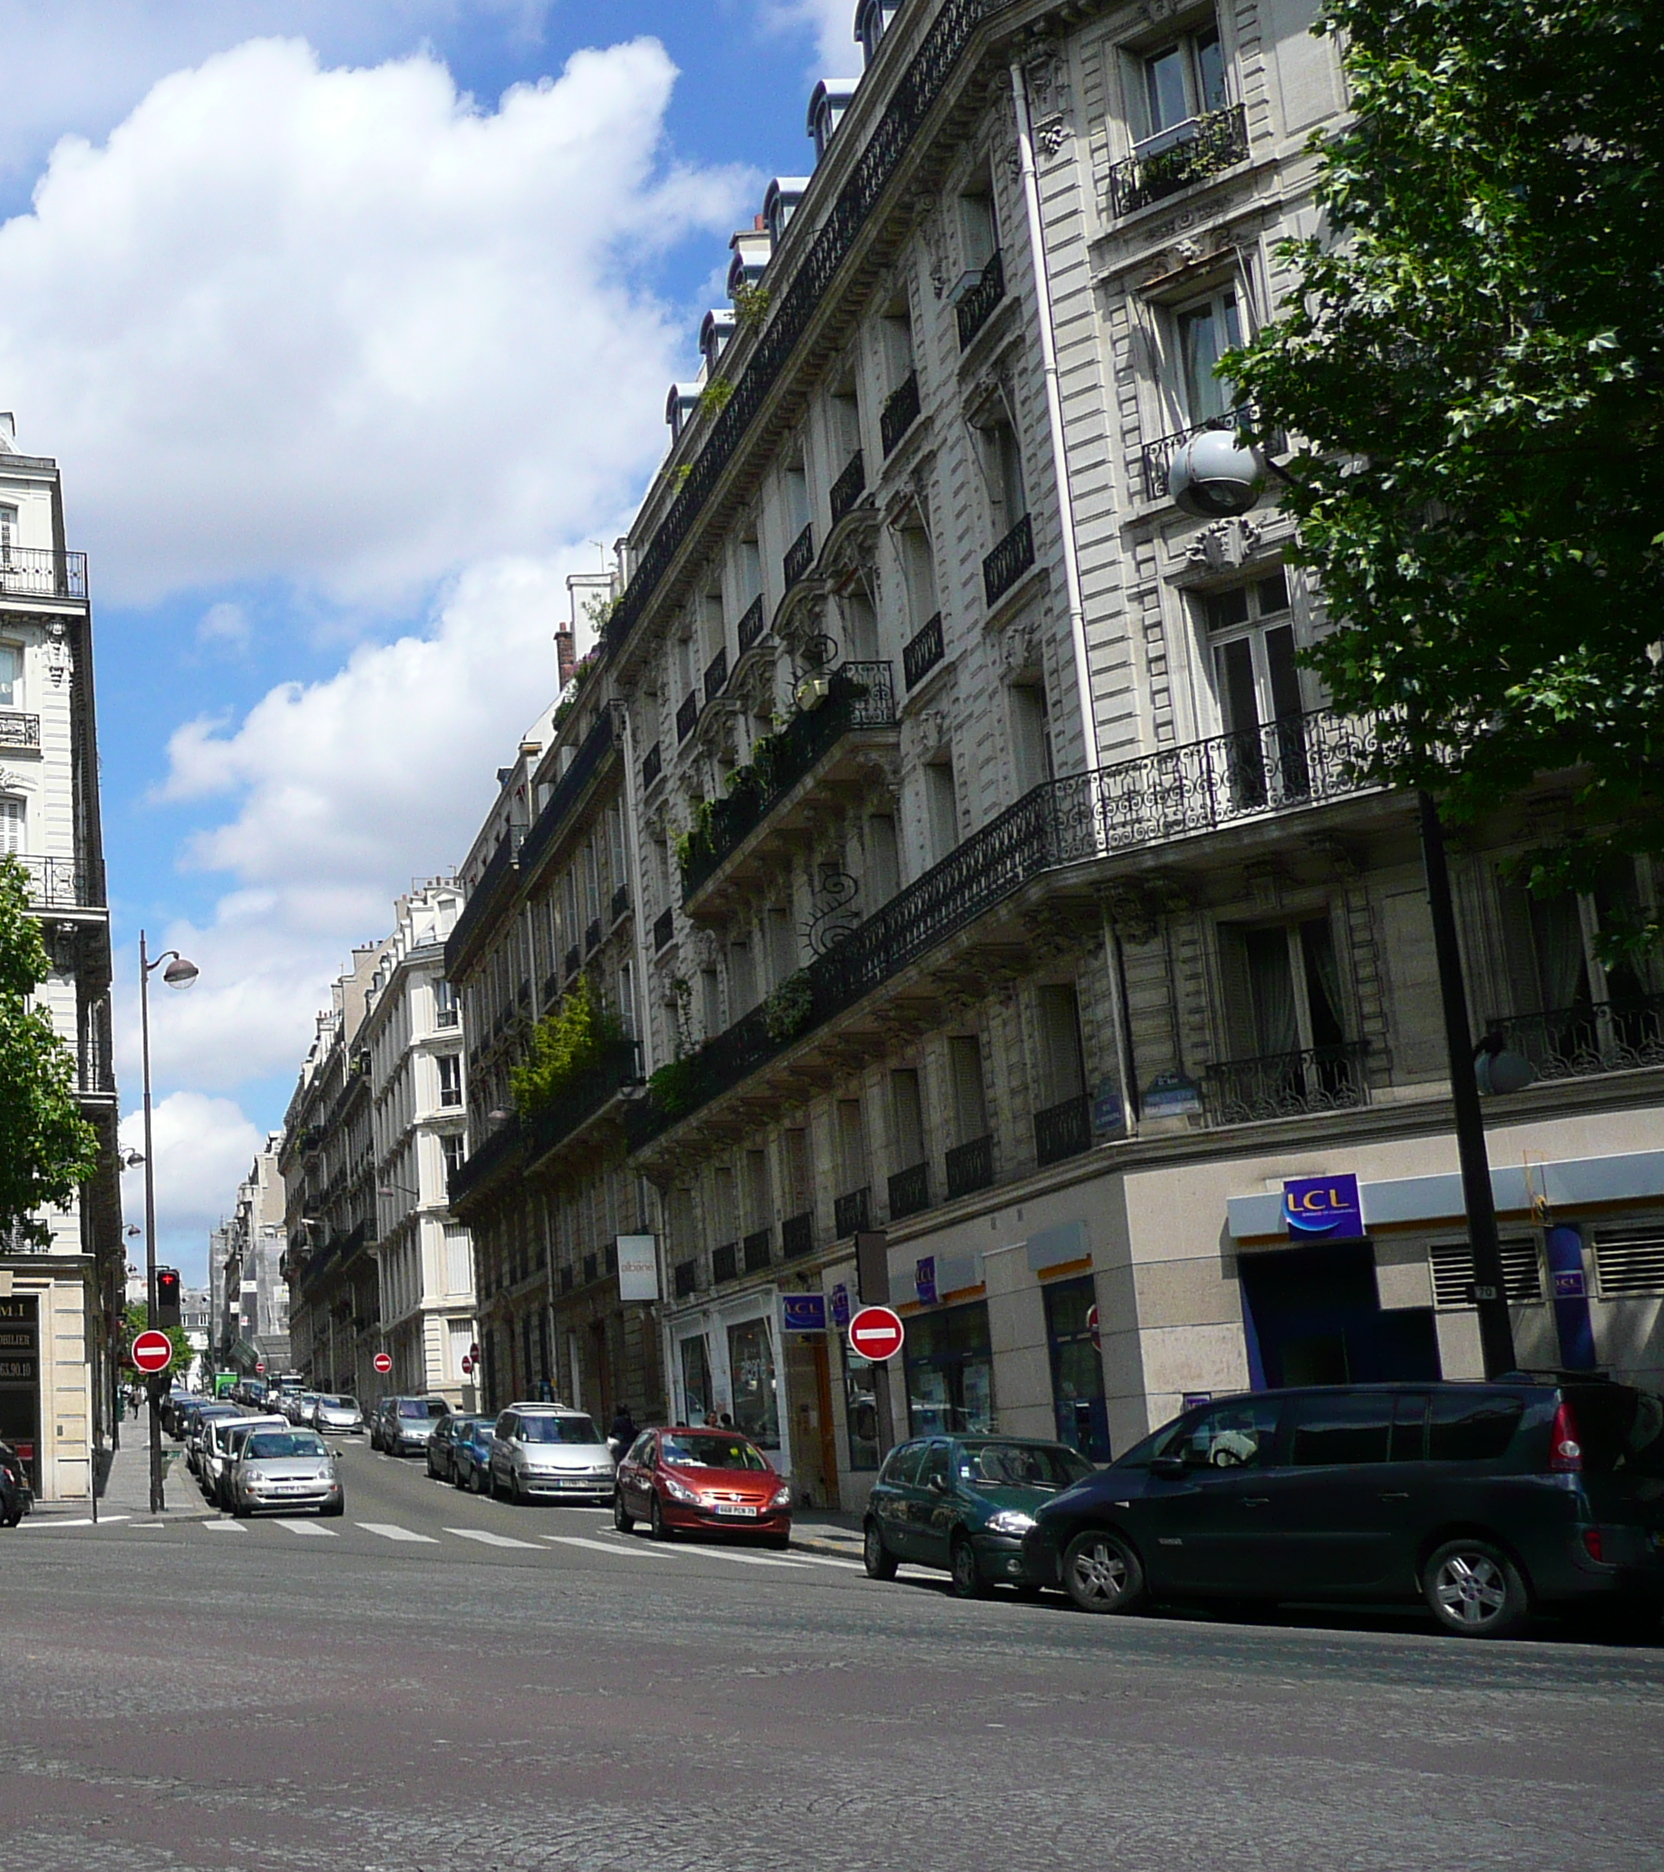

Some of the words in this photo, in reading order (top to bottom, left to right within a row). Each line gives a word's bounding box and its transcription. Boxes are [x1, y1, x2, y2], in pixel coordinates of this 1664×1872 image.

[1287, 1188, 1350, 1212] LCL
[915, 1266, 934, 1285] LCL
[1478, 1287, 1493, 1298] 70
[786, 1301, 821, 1316] LCL
